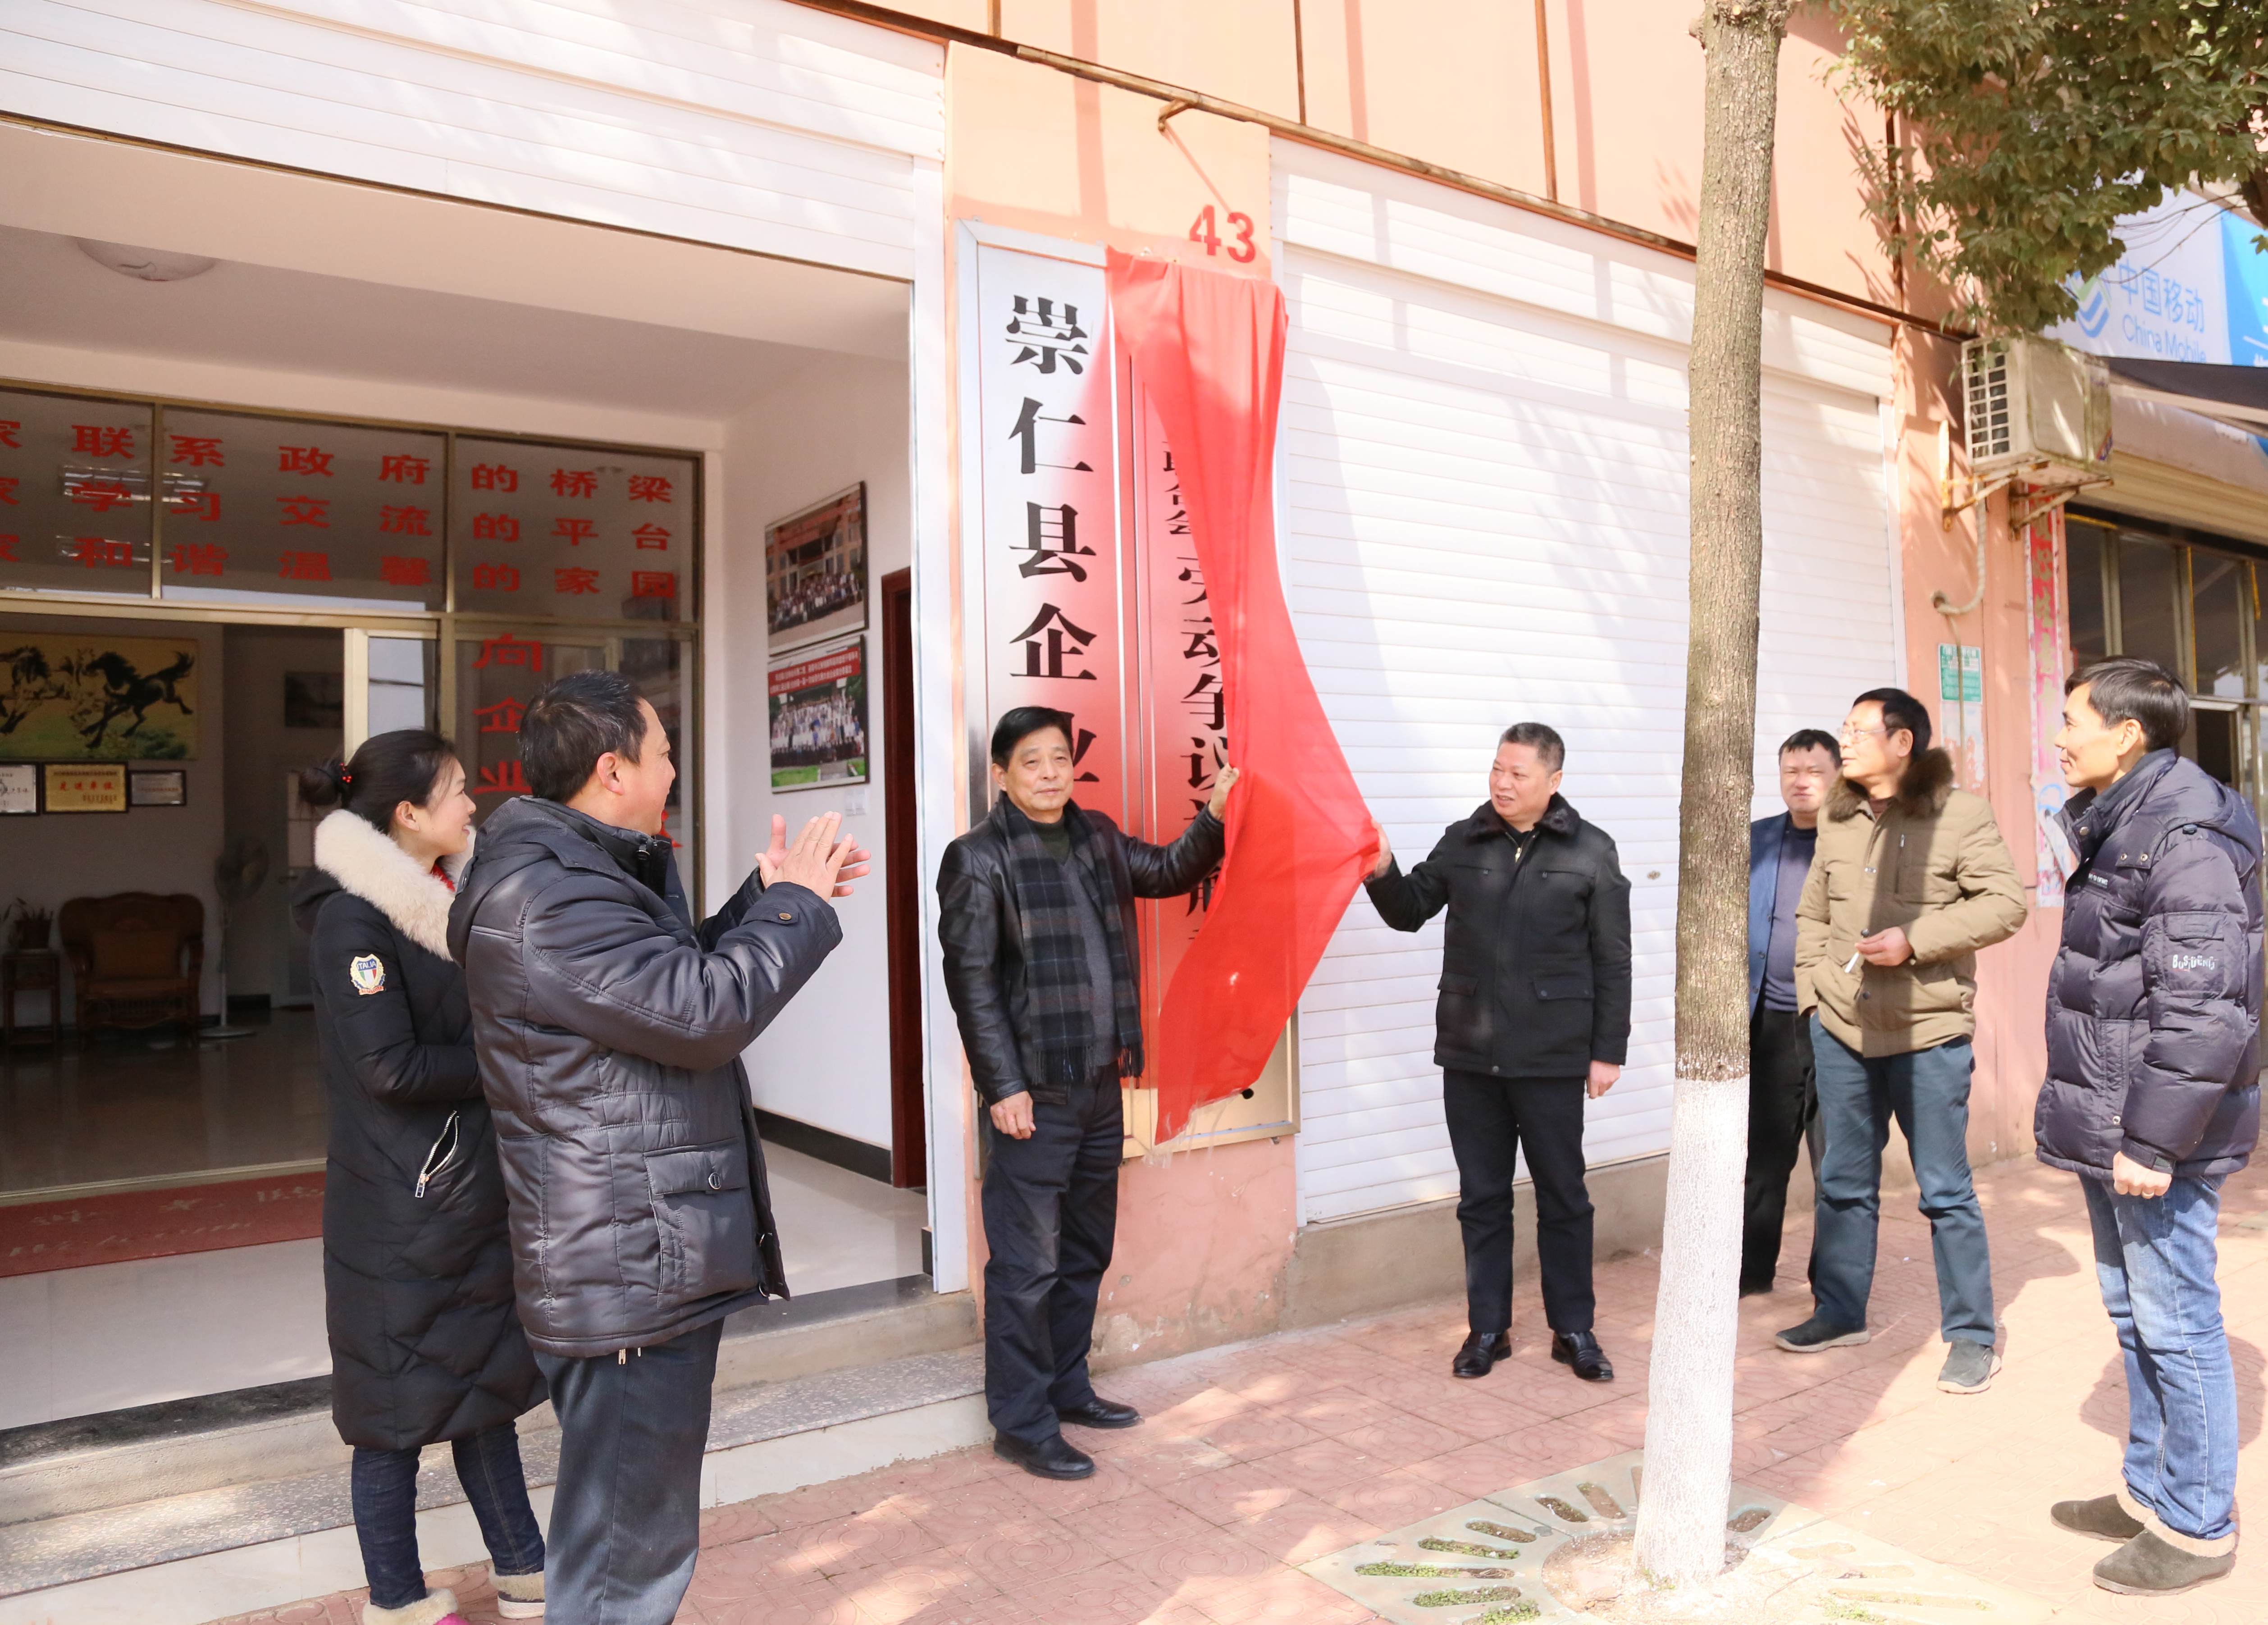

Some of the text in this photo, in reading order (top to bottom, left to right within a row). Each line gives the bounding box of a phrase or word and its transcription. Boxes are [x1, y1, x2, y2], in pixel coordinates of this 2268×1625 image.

[1189, 204, 1255, 263] 43
[2118, 259, 2205, 333] 中国移动
[2122, 315, 2162, 354] China
[2165, 331, 2207, 363] Mobile
[356, 961, 377, 970] ITALIA
